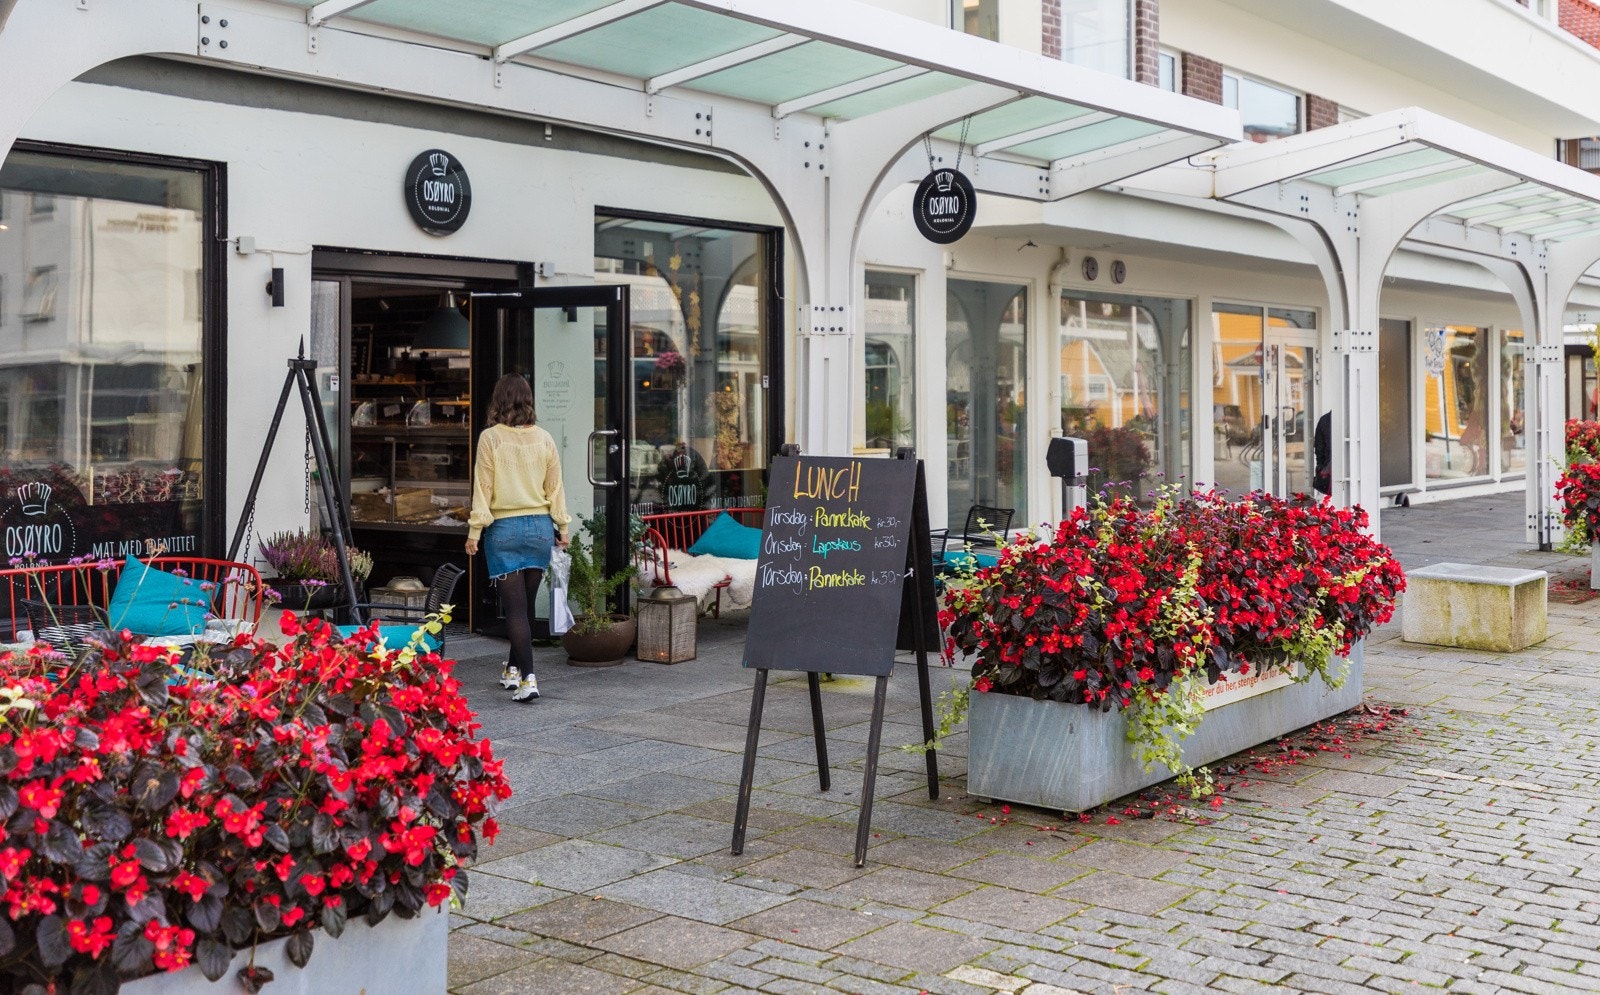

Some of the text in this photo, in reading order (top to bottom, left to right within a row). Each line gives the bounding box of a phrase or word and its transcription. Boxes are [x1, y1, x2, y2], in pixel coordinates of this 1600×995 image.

[424, 180, 455, 204] OSØYRO
[428, 205, 450, 213] KOLONIAL
[929, 196, 960, 215] OSØYRO
[794, 461, 862, 502] LUNCH
[668, 483, 697, 507] OSØYRO
[5, 523, 62, 556] OSØYRO
[92, 541, 115, 559] MAT
[118, 540, 142, 557] MED
[1215, 683, 1226, 695] du
